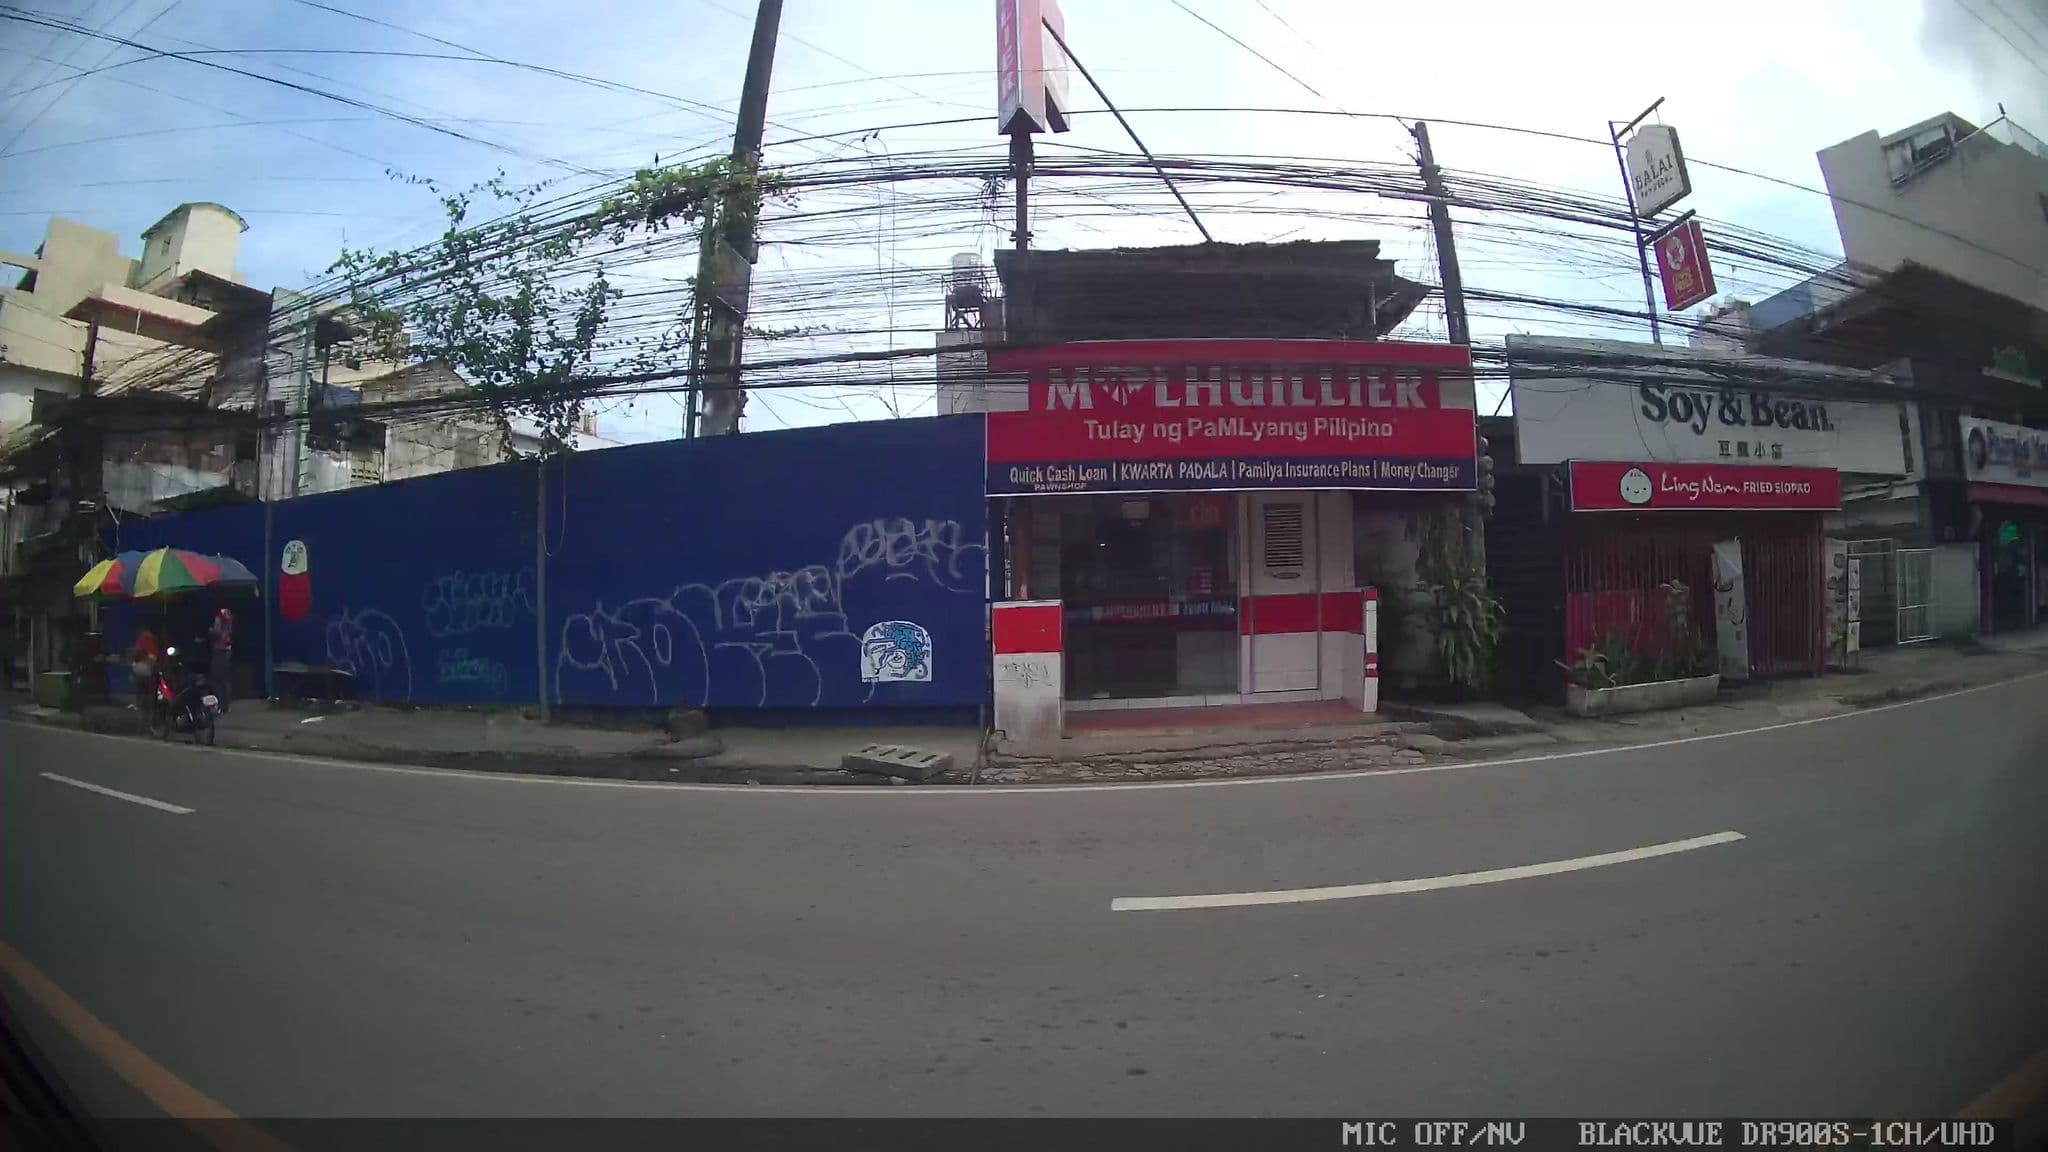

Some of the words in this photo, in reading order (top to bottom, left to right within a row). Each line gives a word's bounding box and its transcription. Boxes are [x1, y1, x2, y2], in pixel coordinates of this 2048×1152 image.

[1635, 153, 1673, 191] BALAI
[1155, 366, 1428, 409] LHUILLIER
[1084, 420, 1145, 444] Tulay
[1153, 424, 1182, 444] ng
[1188, 418, 1308, 442] PaMLyang
[1314, 417, 1394, 440] Pilipino
[1009, 466, 1044, 484] Quick
[1046, 465, 1075, 482] Cash
[1079, 464, 1108, 481] Loan
[1121, 462, 1174, 480] KWARTA
[1179, 462, 1228, 480] PADALA
[1239, 461, 1284, 482] Pamilya
[1285, 462, 1340, 478] Insurance
[1341, 461, 1371, 477] Plans
[1381, 462, 1416, 482] Money
[1417, 462, 1460, 482] Changer
[1660, 470, 1700, 500] Ling
[1702, 474, 1740, 494] Nam
[1743, 481, 1773, 494] FRIED
[1034, 482, 1088, 492] PAWNSHOP
